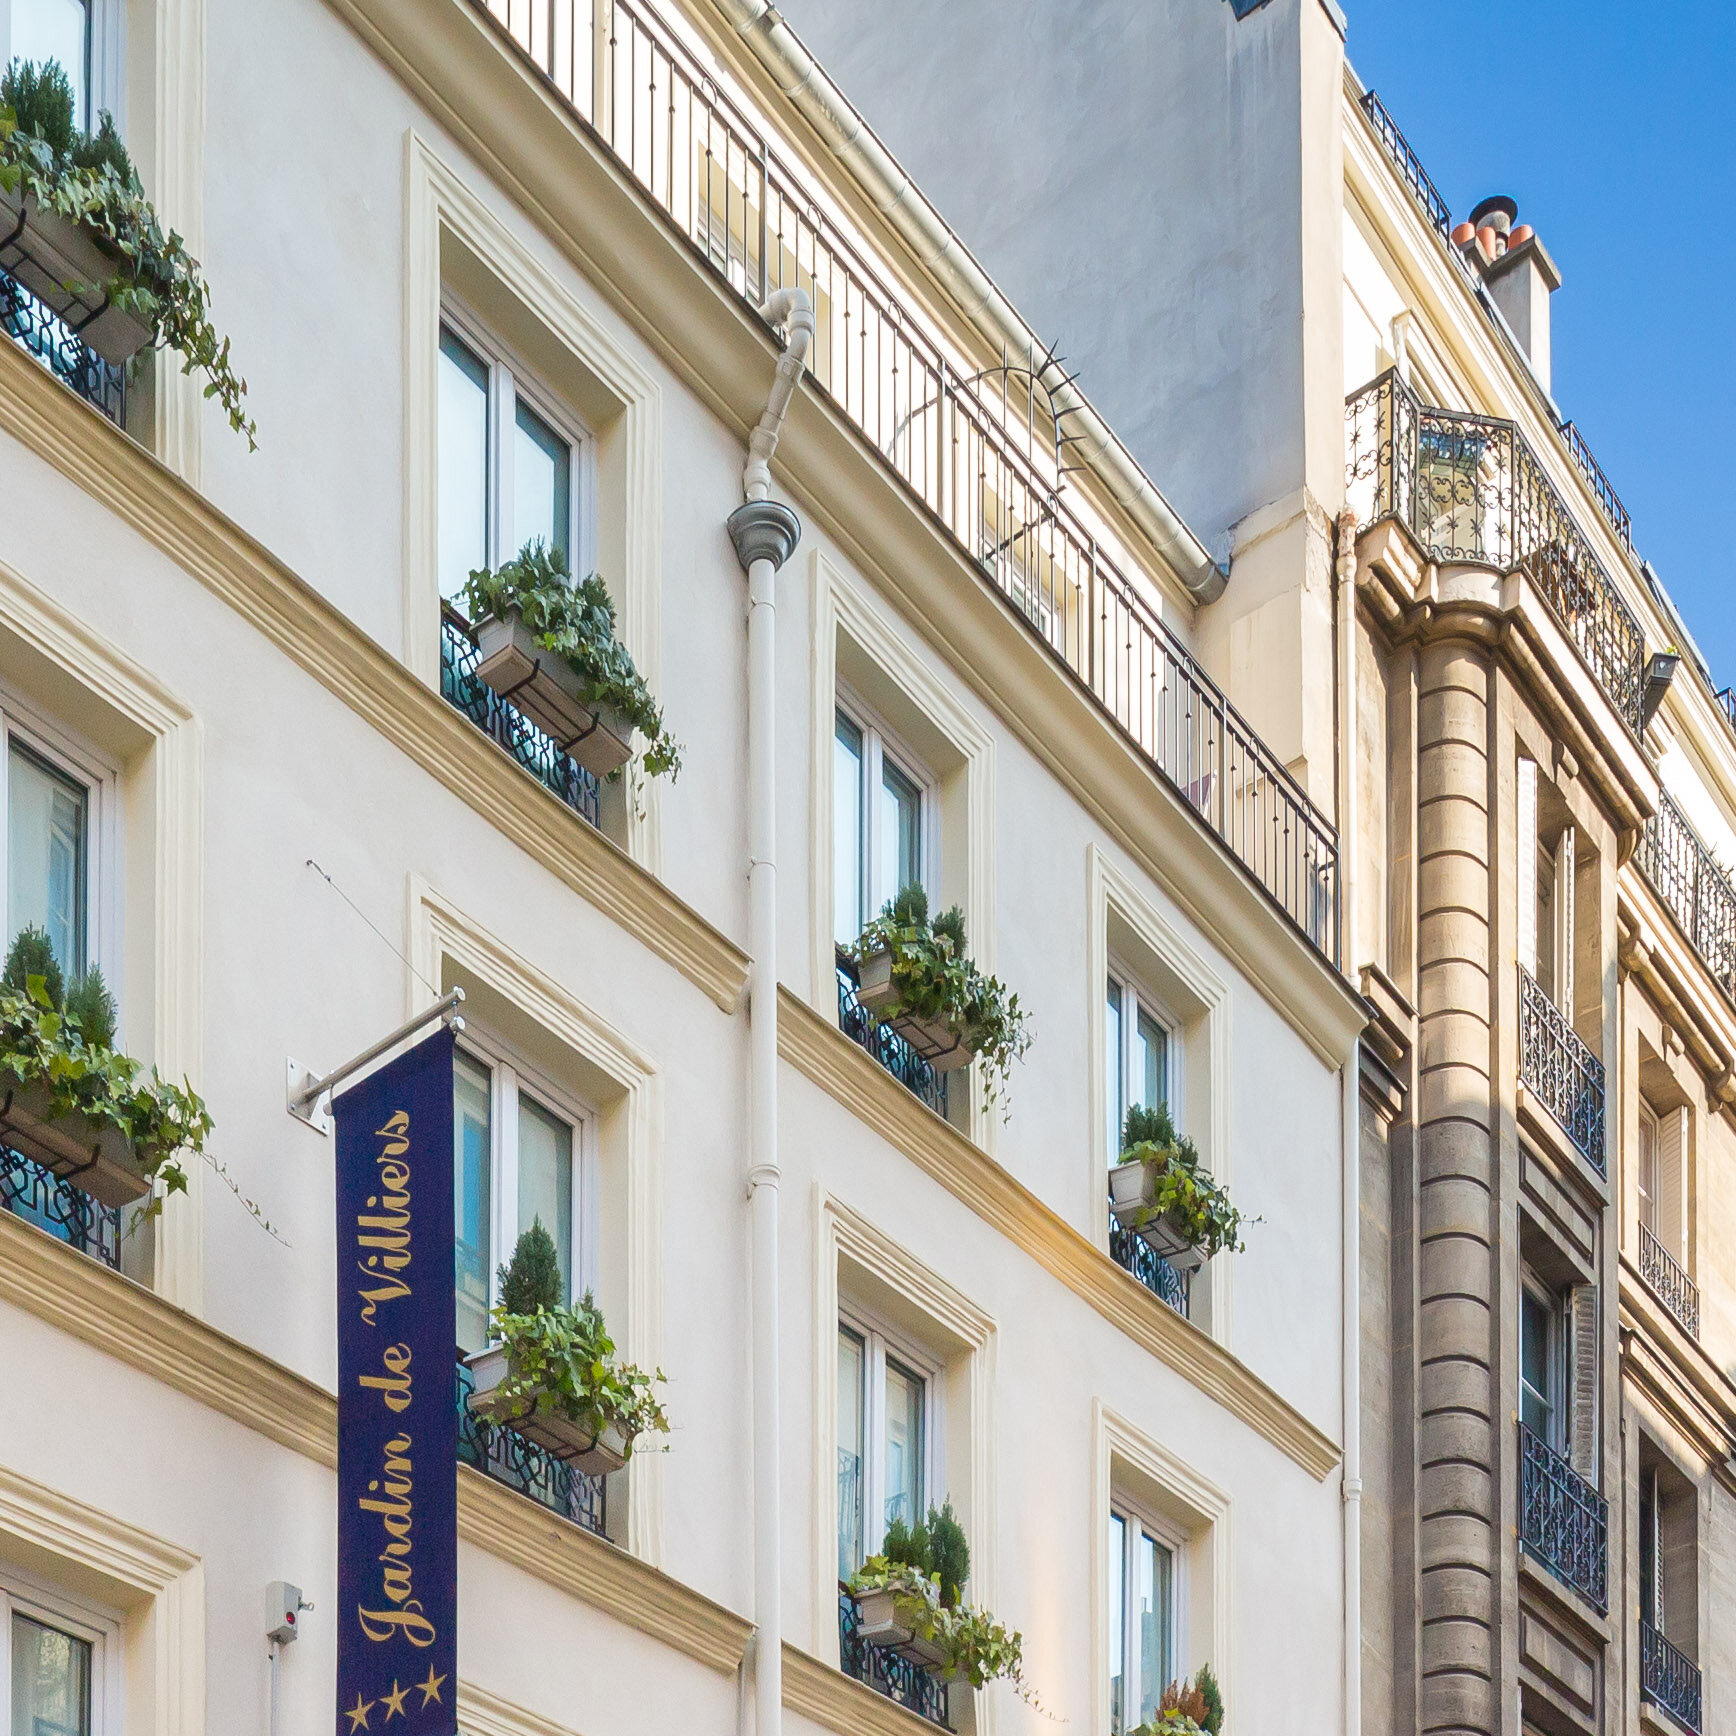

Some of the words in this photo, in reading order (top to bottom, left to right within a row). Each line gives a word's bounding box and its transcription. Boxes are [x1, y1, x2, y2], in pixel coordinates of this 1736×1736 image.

[357, 1110, 412, 1327] Villiers
[358, 1342, 413, 1413] de
[358, 1432, 436, 1648] Jardin
